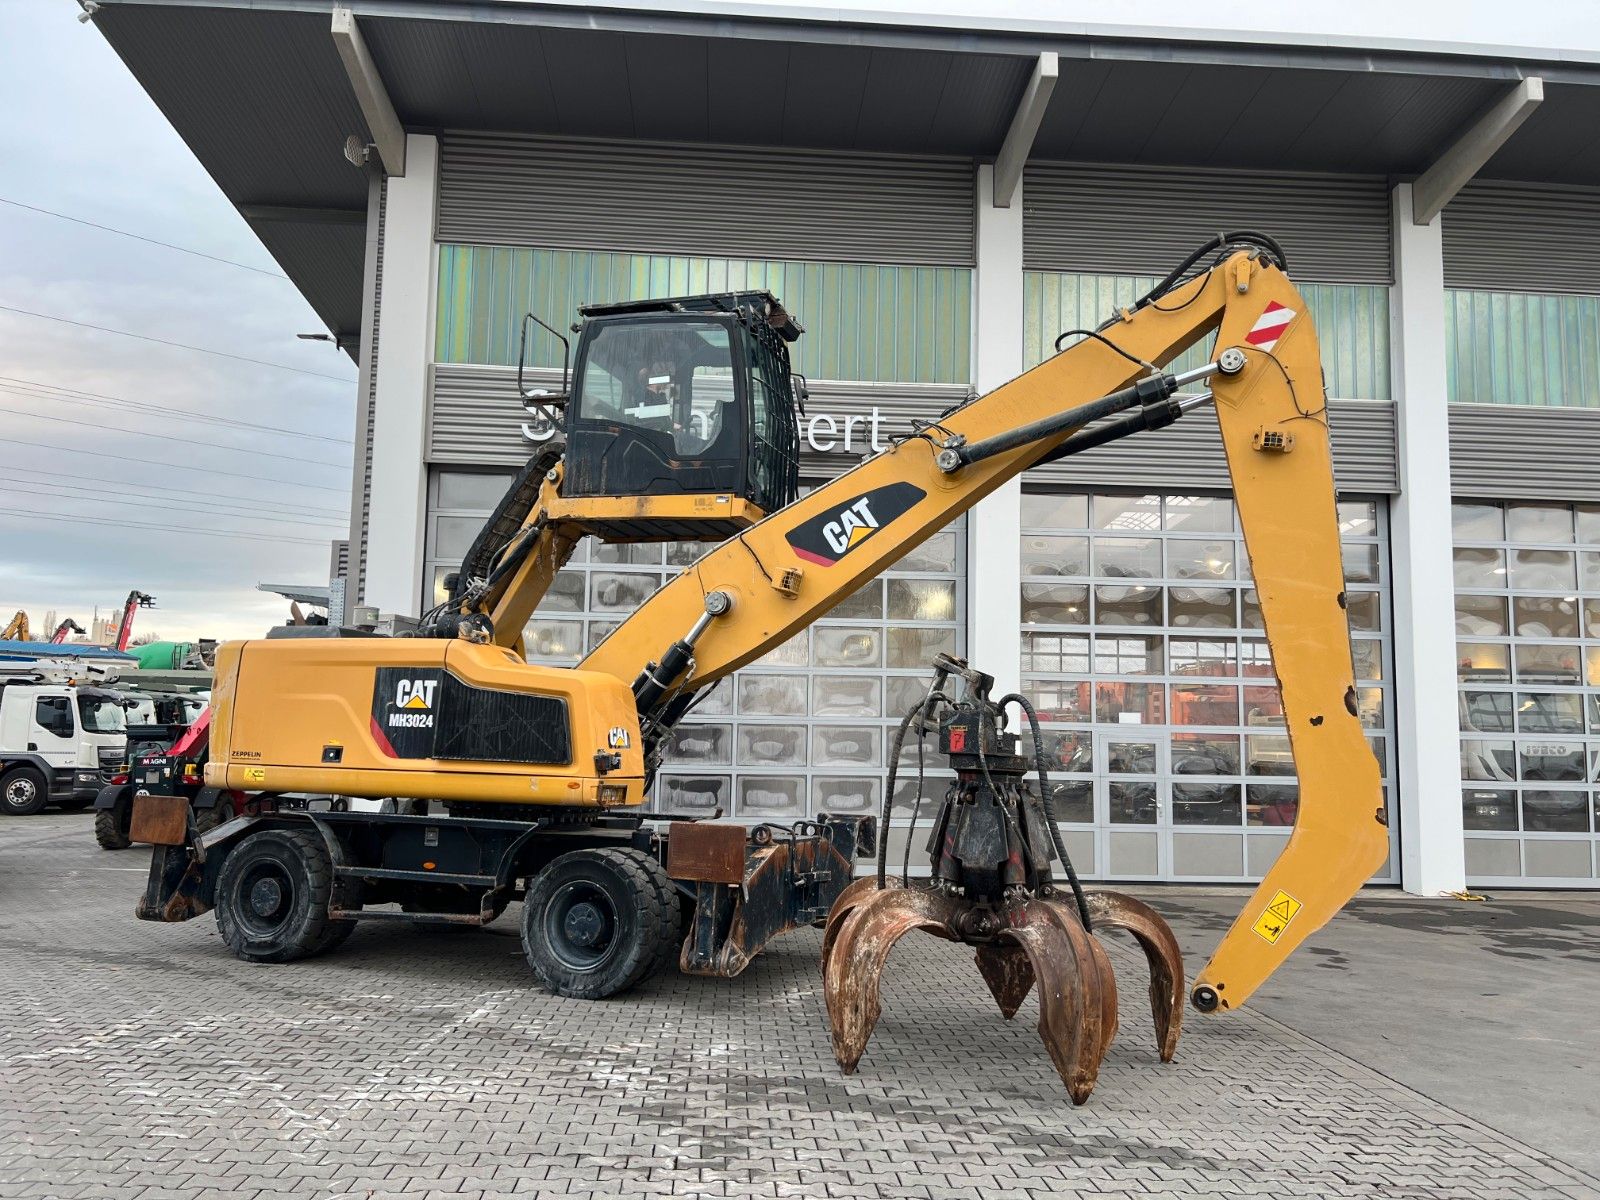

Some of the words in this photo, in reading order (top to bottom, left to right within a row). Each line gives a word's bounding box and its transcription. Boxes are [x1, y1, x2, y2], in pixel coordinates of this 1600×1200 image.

[822, 497, 880, 554] CAT
[396, 679, 438, 709] CAT
[389, 713, 434, 728] MH3024
[609, 727, 629, 746] CAT
[231, 750, 262, 758] ZEPPELIN
[1526, 745, 1567, 755] IVECO
